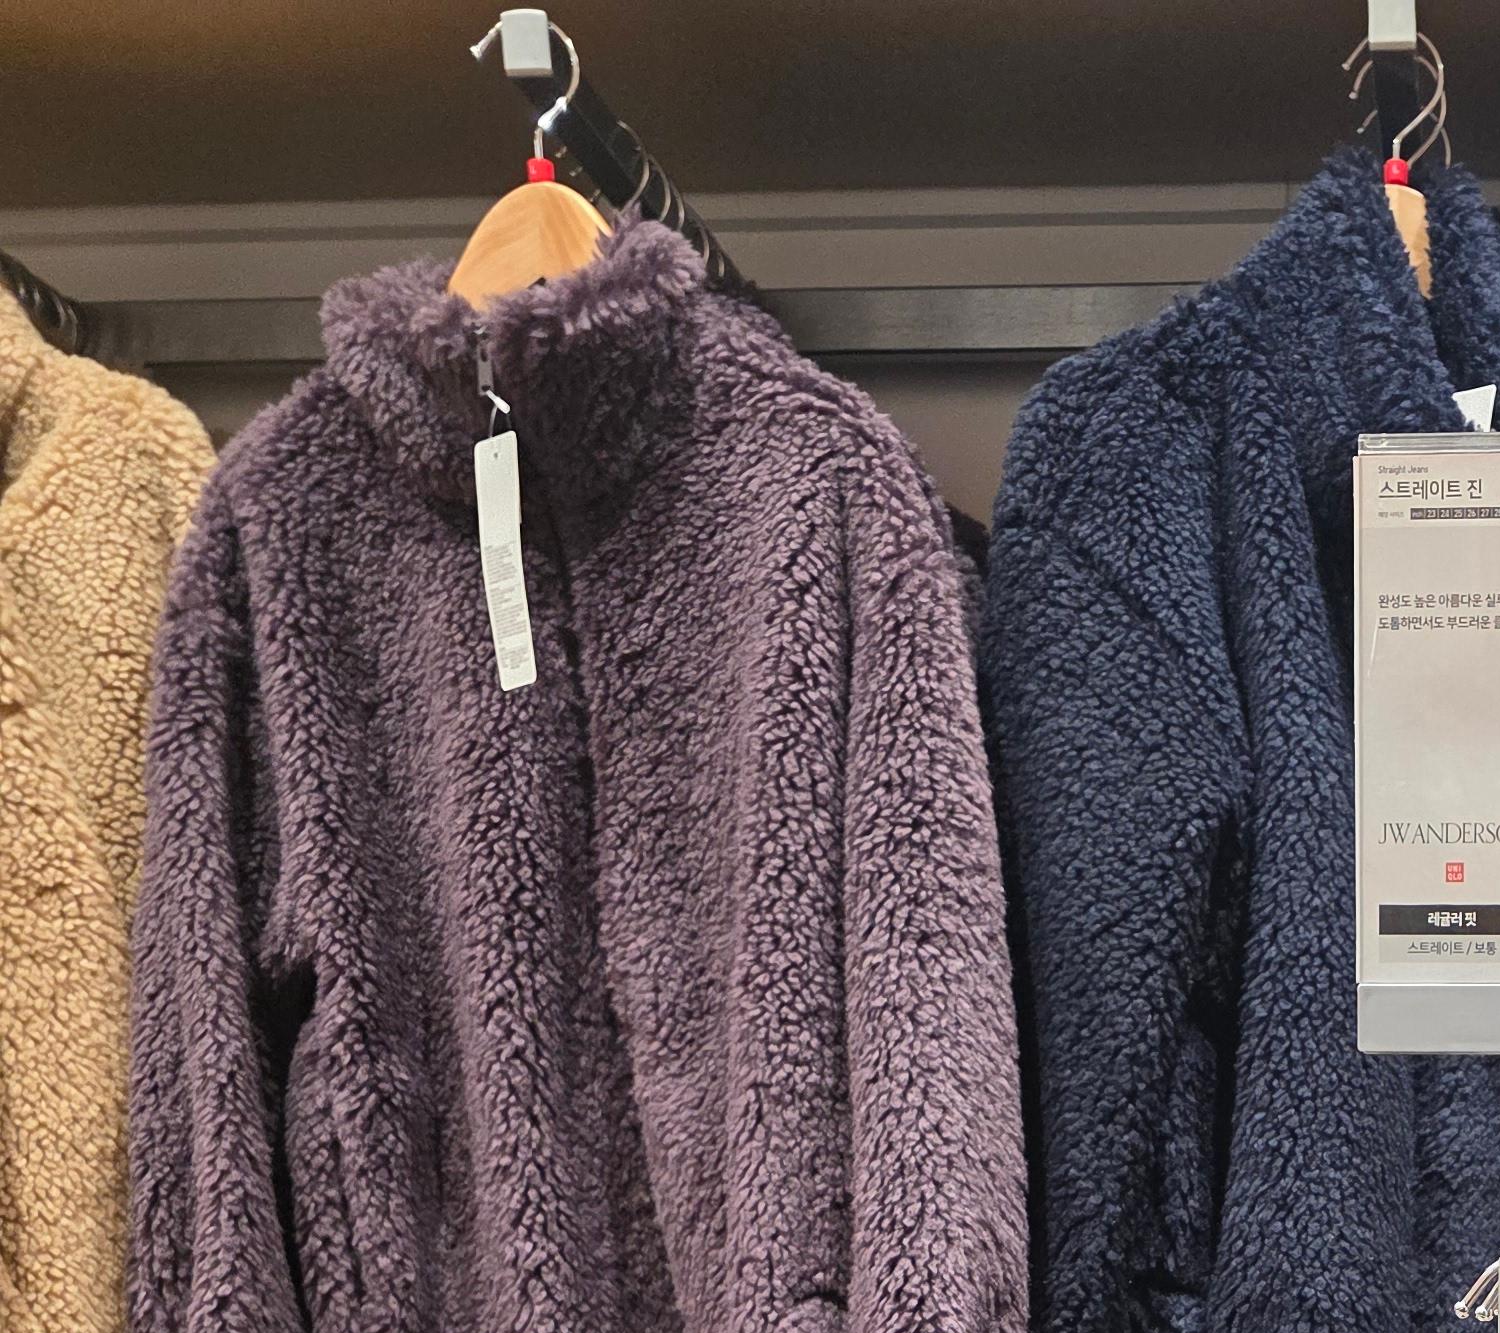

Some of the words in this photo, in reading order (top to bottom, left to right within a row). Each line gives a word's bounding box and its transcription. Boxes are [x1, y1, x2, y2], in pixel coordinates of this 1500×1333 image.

[1378, 465, 1406, 475] Straight
[1408, 465, 1429, 474] Jeans
[1378, 479, 1462, 500] 스트레이트
[1467, 479, 1482, 499] 진
[1427, 509, 1436, 518] 23
[1440, 509, 1450, 518] 24
[1454, 508, 1463, 518] 25
[1467, 508, 1477, 518] 26
[1480, 508, 1490, 518] 27
[1378, 594, 1412, 609] 완성도
[1414, 594, 1436, 608] 높은
[1438, 594, 1482, 608] 아름다운
[1378, 616, 1445, 630] 도톰하면서도
[1447, 616, 1490, 630] 부드러운
[1427, 911, 1463, 927] 레귤러
[1465, 911, 1477, 927] 핏
[1407, 941, 1465, 956] 스트레이트
[1473, 941, 1497, 956] 보통
